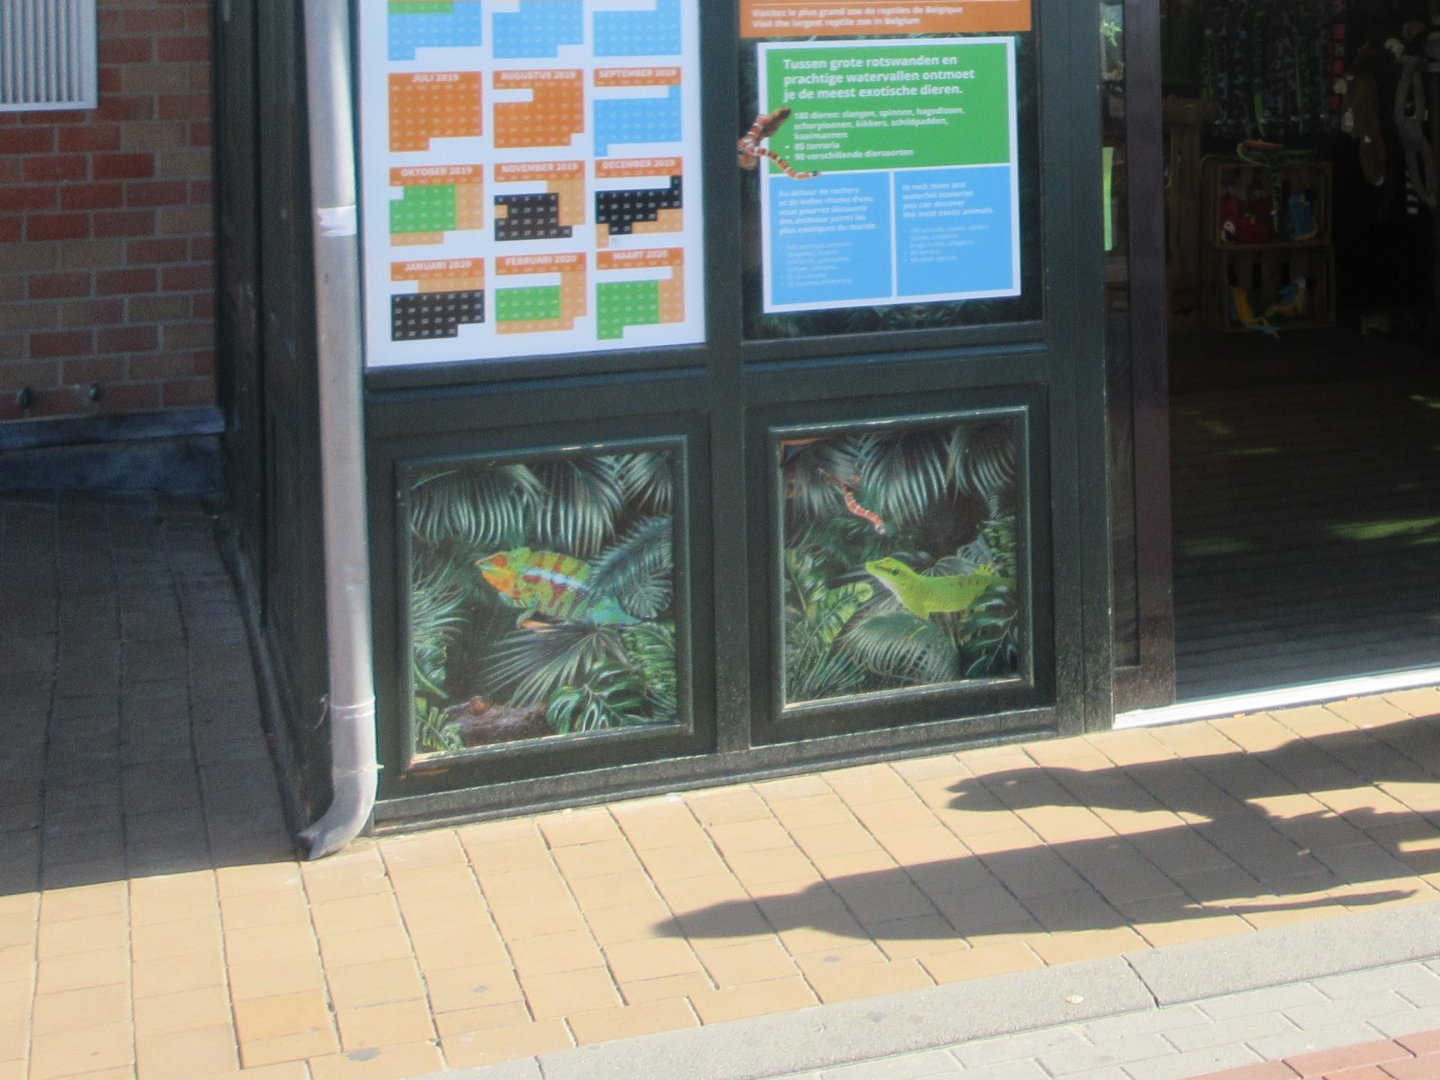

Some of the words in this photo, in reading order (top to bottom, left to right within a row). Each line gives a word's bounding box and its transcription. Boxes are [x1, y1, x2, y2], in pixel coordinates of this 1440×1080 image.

[783, 59, 827, 69] Tussen
[829, 59, 863, 71] grote
[866, 56, 939, 67] rotswanden
[942, 56, 957, 65] en
[502, 71, 553, 80] AUGUSTUS
[600, 69, 654, 78] SEPTEMBER
[784, 73, 843, 88] prachtige
[846, 70, 919, 82] watervallen
[922, 70, 976, 80] ontmoet
[783, 89, 795, 103] je
[799, 88, 814, 99] de
[817, 88, 856, 98] meest
[859, 85, 918, 97] exotische
[920, 84, 963, 95] dieren.
[501, 163, 555, 173] NOVEMBER
[556, 162, 579, 171] 2019
[602, 160, 652, 169] DECEMBER
[653, 159, 676, 168] 2019
[401, 167, 447, 177] OKTOBER
[449, 166, 472, 176] 2019
[505, 256, 552, 266] FEBRUARI
[555, 255, 577, 263] 2020
[612, 251, 644, 260] MAART
[404, 261, 447, 271] JANUARI
[448, 260, 473, 270] 2020
